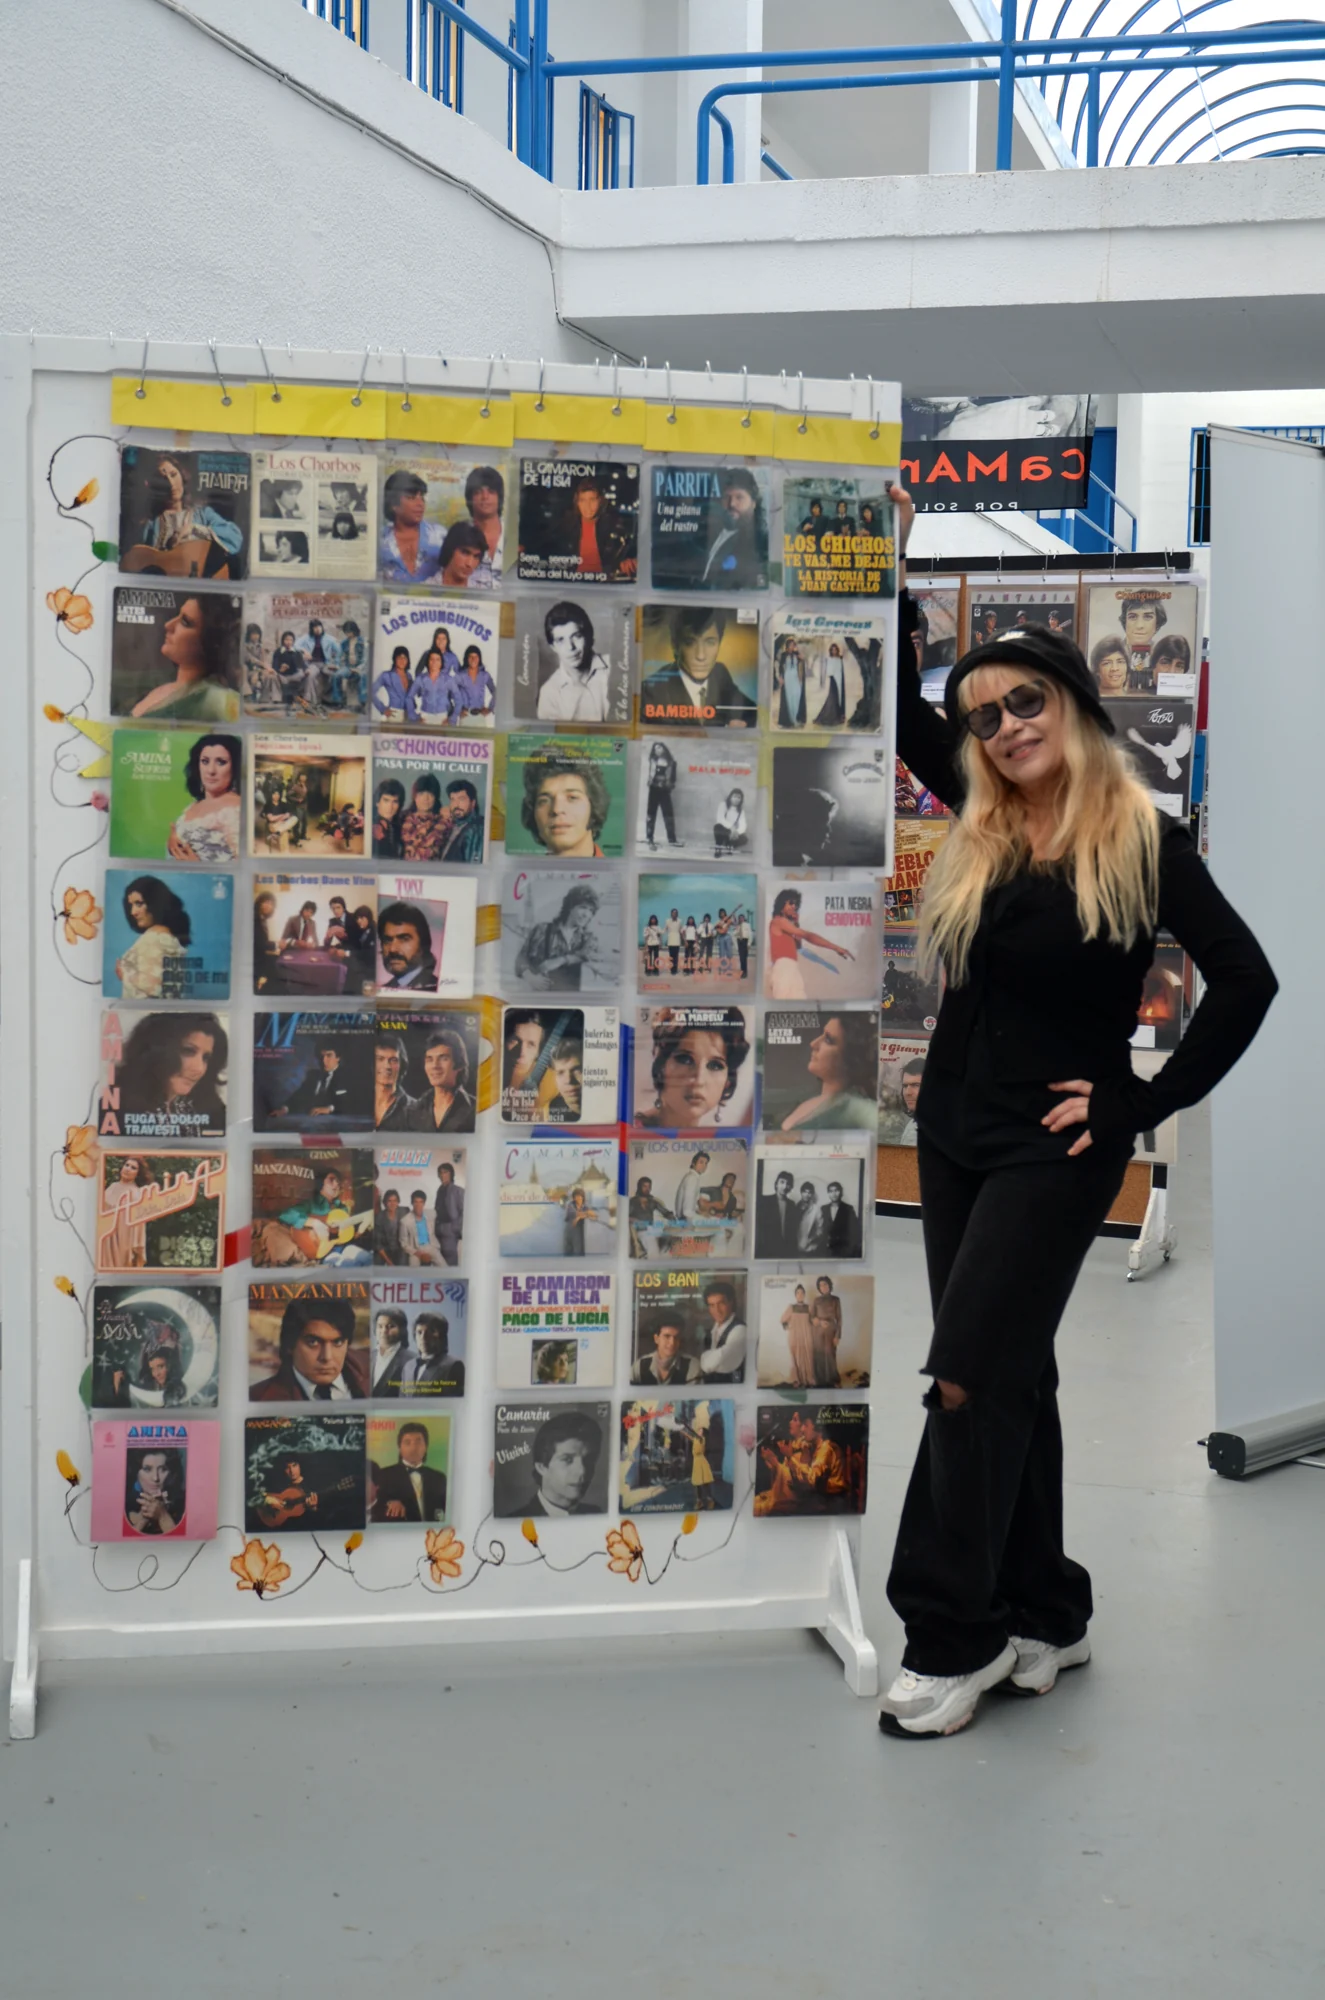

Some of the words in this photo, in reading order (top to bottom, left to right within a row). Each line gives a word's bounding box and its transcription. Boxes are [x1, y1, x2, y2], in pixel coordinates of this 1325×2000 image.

[269, 454, 295, 470] Los
[301, 456, 361, 472] Chorbos
[523, 462, 536, 473] EL
[538, 463, 595, 477] CAMARON
[523, 474, 539, 486] DE
[553, 476, 571, 488] ISLA
[655, 471, 721, 498] PARRITA
[657, 502, 674, 515] Una
[675, 502, 701, 518] gitana
[660, 519, 672, 531] del
[673, 521, 698, 532] rastro
[784, 535, 816, 552] LOS
[820, 536, 894, 554] CHICHOS
[784, 554, 800, 567] TE
[855, 555, 894, 568] DEJAS
[548, 568, 561, 579] del
[563, 569, 581, 581] tuyo
[584, 573, 594, 581] se
[595, 573, 607, 581] va
[798, 570, 813, 580] LA
[814, 570, 864, 581] HISTORIA
[867, 572, 880, 581] DE
[800, 581, 827, 592] JUAN
[831, 582, 880, 592] CASTILLO
[117, 590, 176, 608] AMINA
[976, 593, 1071, 603] FANTASIA
[382, 615, 408, 635] LOS
[410, 611, 492, 642] CHUNGUITOS
[617, 674, 628, 697] dice
[617, 699, 628, 709] lo
[645, 704, 716, 719] BAMBINO
[373, 739, 398, 752] LOS
[397, 739, 489, 758] CHUNGUITOS
[120, 752, 171, 765] AMINA
[375, 758, 403, 768] PASA
[406, 760, 430, 770] POR
[433, 762, 446, 771] MI
[449, 762, 482, 773] CALLE
[893, 850, 935, 872] EBLO
[825, 896, 845, 911] PATA
[848, 897, 872, 911] NEGRA
[825, 912, 872, 927] GENOVEVA
[675, 1013, 686, 1022] LA
[768, 1013, 820, 1028] AMINA
[100, 1012, 123, 1135] AMINA
[584, 1067, 608, 1076] tientos
[125, 1113, 156, 1124] FUGA
[158, 1114, 167, 1124] Y
[170, 1114, 209, 1124] DOLOR
[511, 1112, 528, 1122] Paco
[531, 1112, 539, 1122] de
[125, 1125, 180, 1135] TRAVESTI
[648, 1142, 668, 1153] LOS
[671, 1141, 744, 1154] CHUNGUITOS
[253, 1163, 315, 1180] MANZANITA
[529, 1192, 539, 1202] de
[503, 1276, 521, 1291] EL
[525, 1276, 610, 1290] CAMARON
[637, 1273, 661, 1287] LOS
[668, 1272, 700, 1287] BANI
[372, 1283, 445, 1304] CHELES
[512, 1290, 532, 1305] DE
[538, 1290, 558, 1305] LA
[564, 1290, 600, 1304] ISLA
[502, 1313, 539, 1326] PACO
[545, 1313, 563, 1325] DE
[569, 1312, 609, 1325] LUCIA
[497, 1407, 550, 1421] Camarón
[128, 1426, 187, 1437] AMINA
